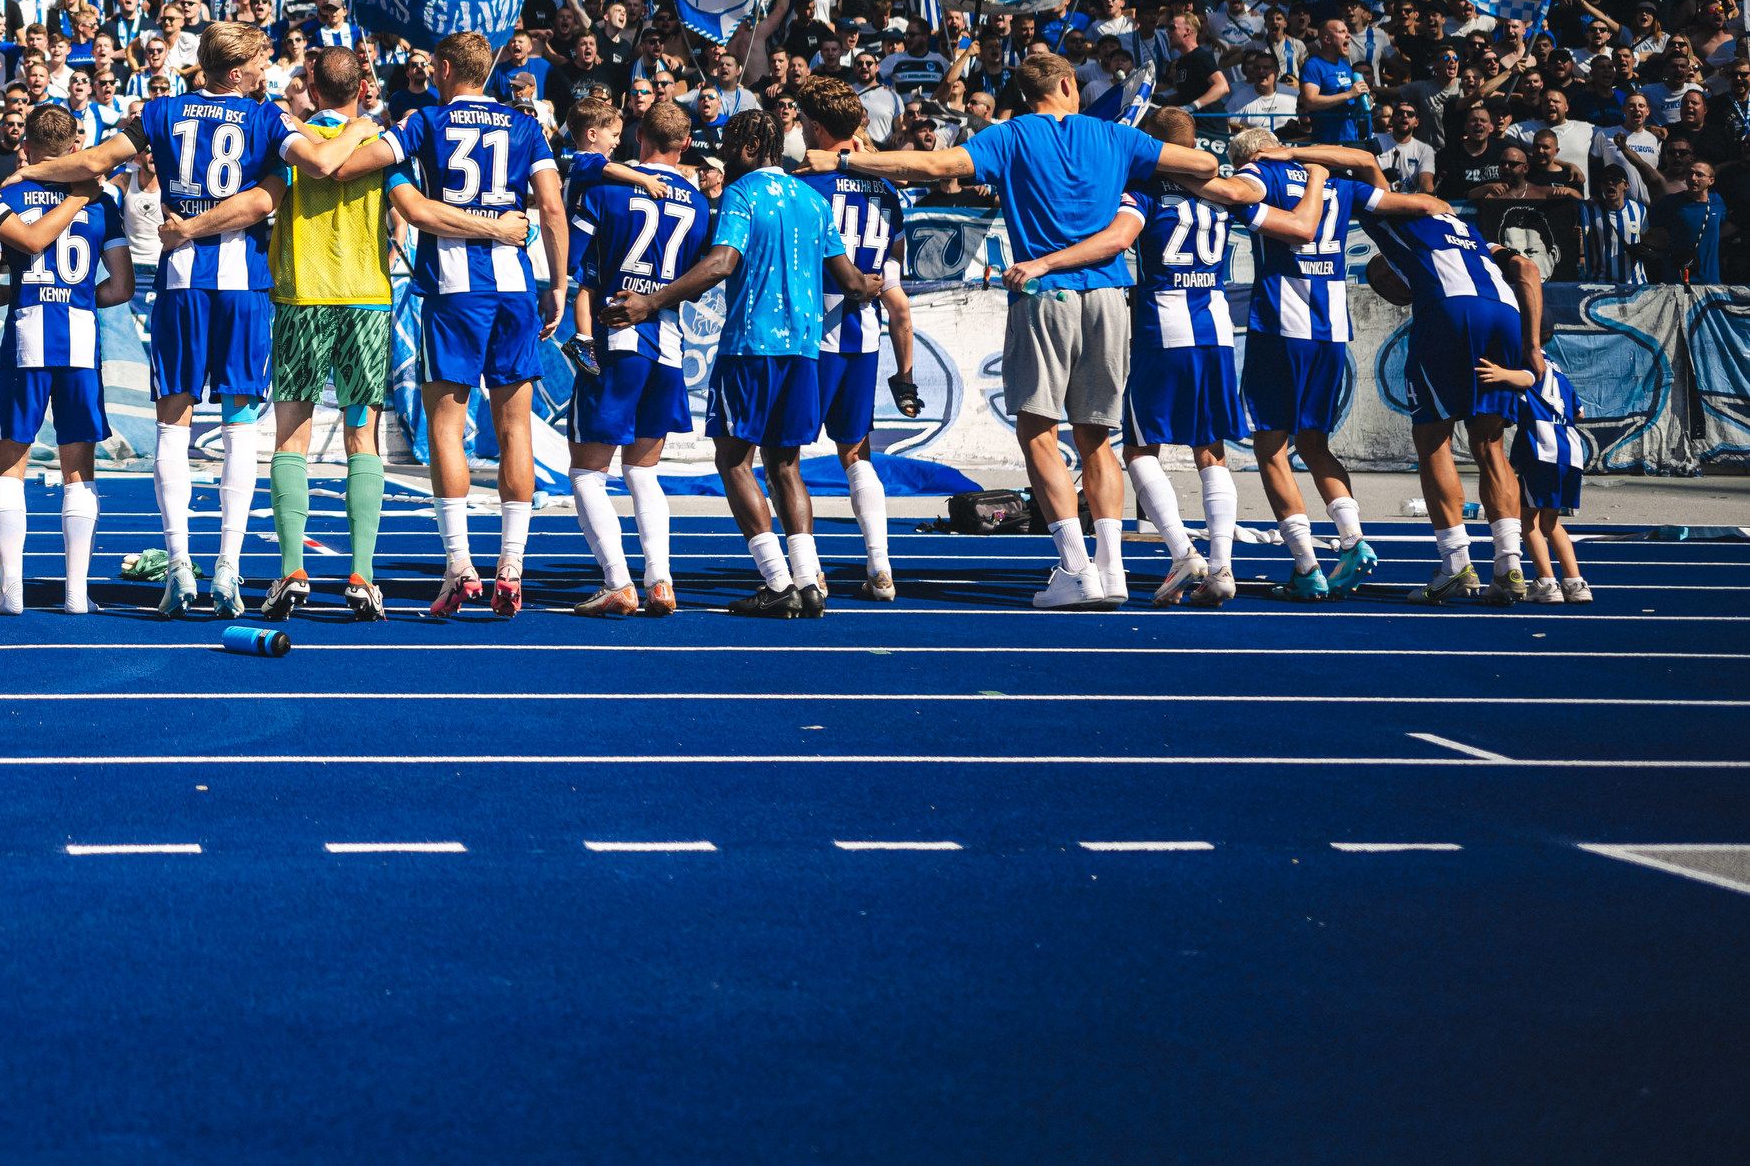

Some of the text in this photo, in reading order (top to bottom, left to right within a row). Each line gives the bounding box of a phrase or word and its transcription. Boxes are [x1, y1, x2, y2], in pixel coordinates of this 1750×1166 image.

[183, 104, 246, 124] HERTHA BSC
[450, 110, 512, 128] HERTHA BSC
[169, 119, 246, 199] 18
[442, 122, 516, 205] 31
[674, 188, 693, 204] BSC
[835, 178, 888, 195] HERTHA BSC
[23, 191, 65, 206] HERTHA
[619, 197, 697, 280] 27
[1161, 194, 1229, 266] 20
[18, 203, 91, 285] 16
[1444, 234, 1478, 251] KEMPF
[1298, 260, 1335, 276] WINKLER
[622, 275, 670, 295] CUISAN
[39, 286, 72, 304] KENNY
